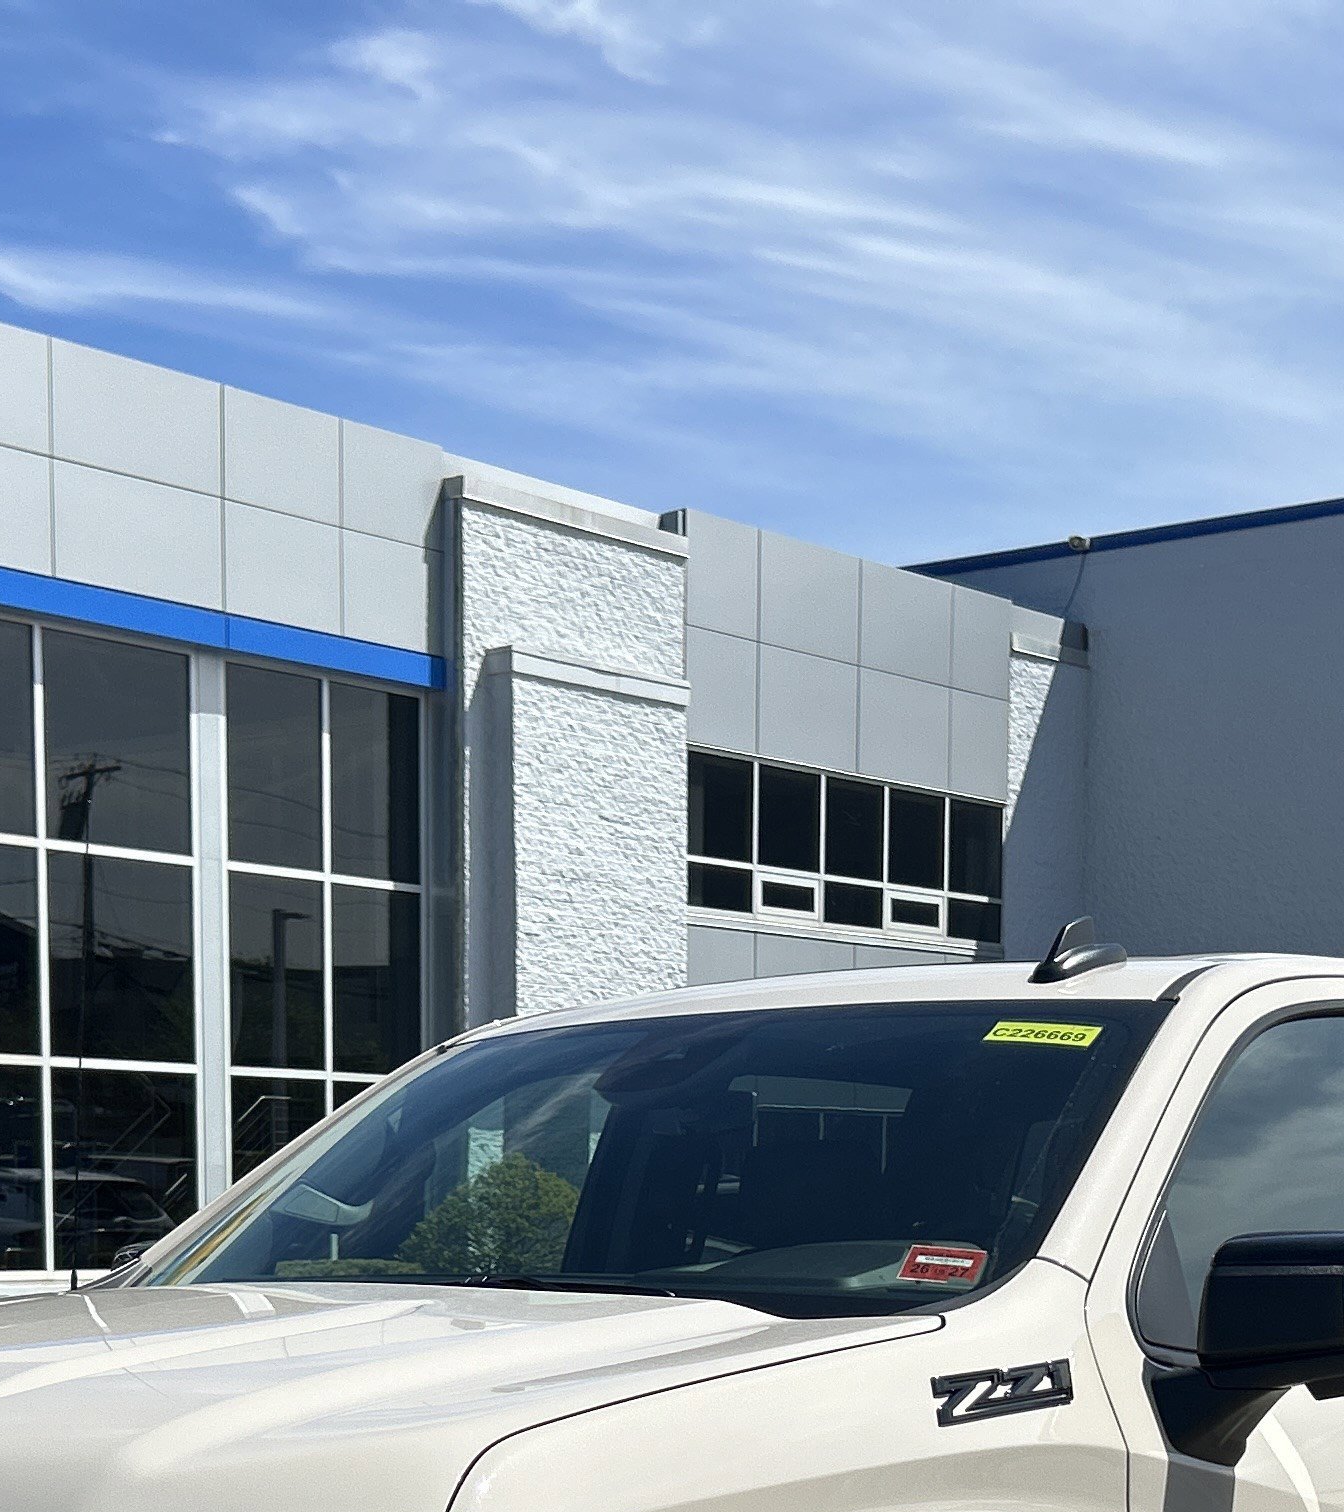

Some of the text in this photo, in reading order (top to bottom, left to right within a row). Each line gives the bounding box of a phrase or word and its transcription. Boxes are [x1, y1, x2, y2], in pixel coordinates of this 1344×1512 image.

[992, 1027, 1087, 1043] C226669
[910, 1264, 930, 1274] 26
[948, 1267, 970, 1278] 27
[930, 1358, 1074, 1427] Z71
